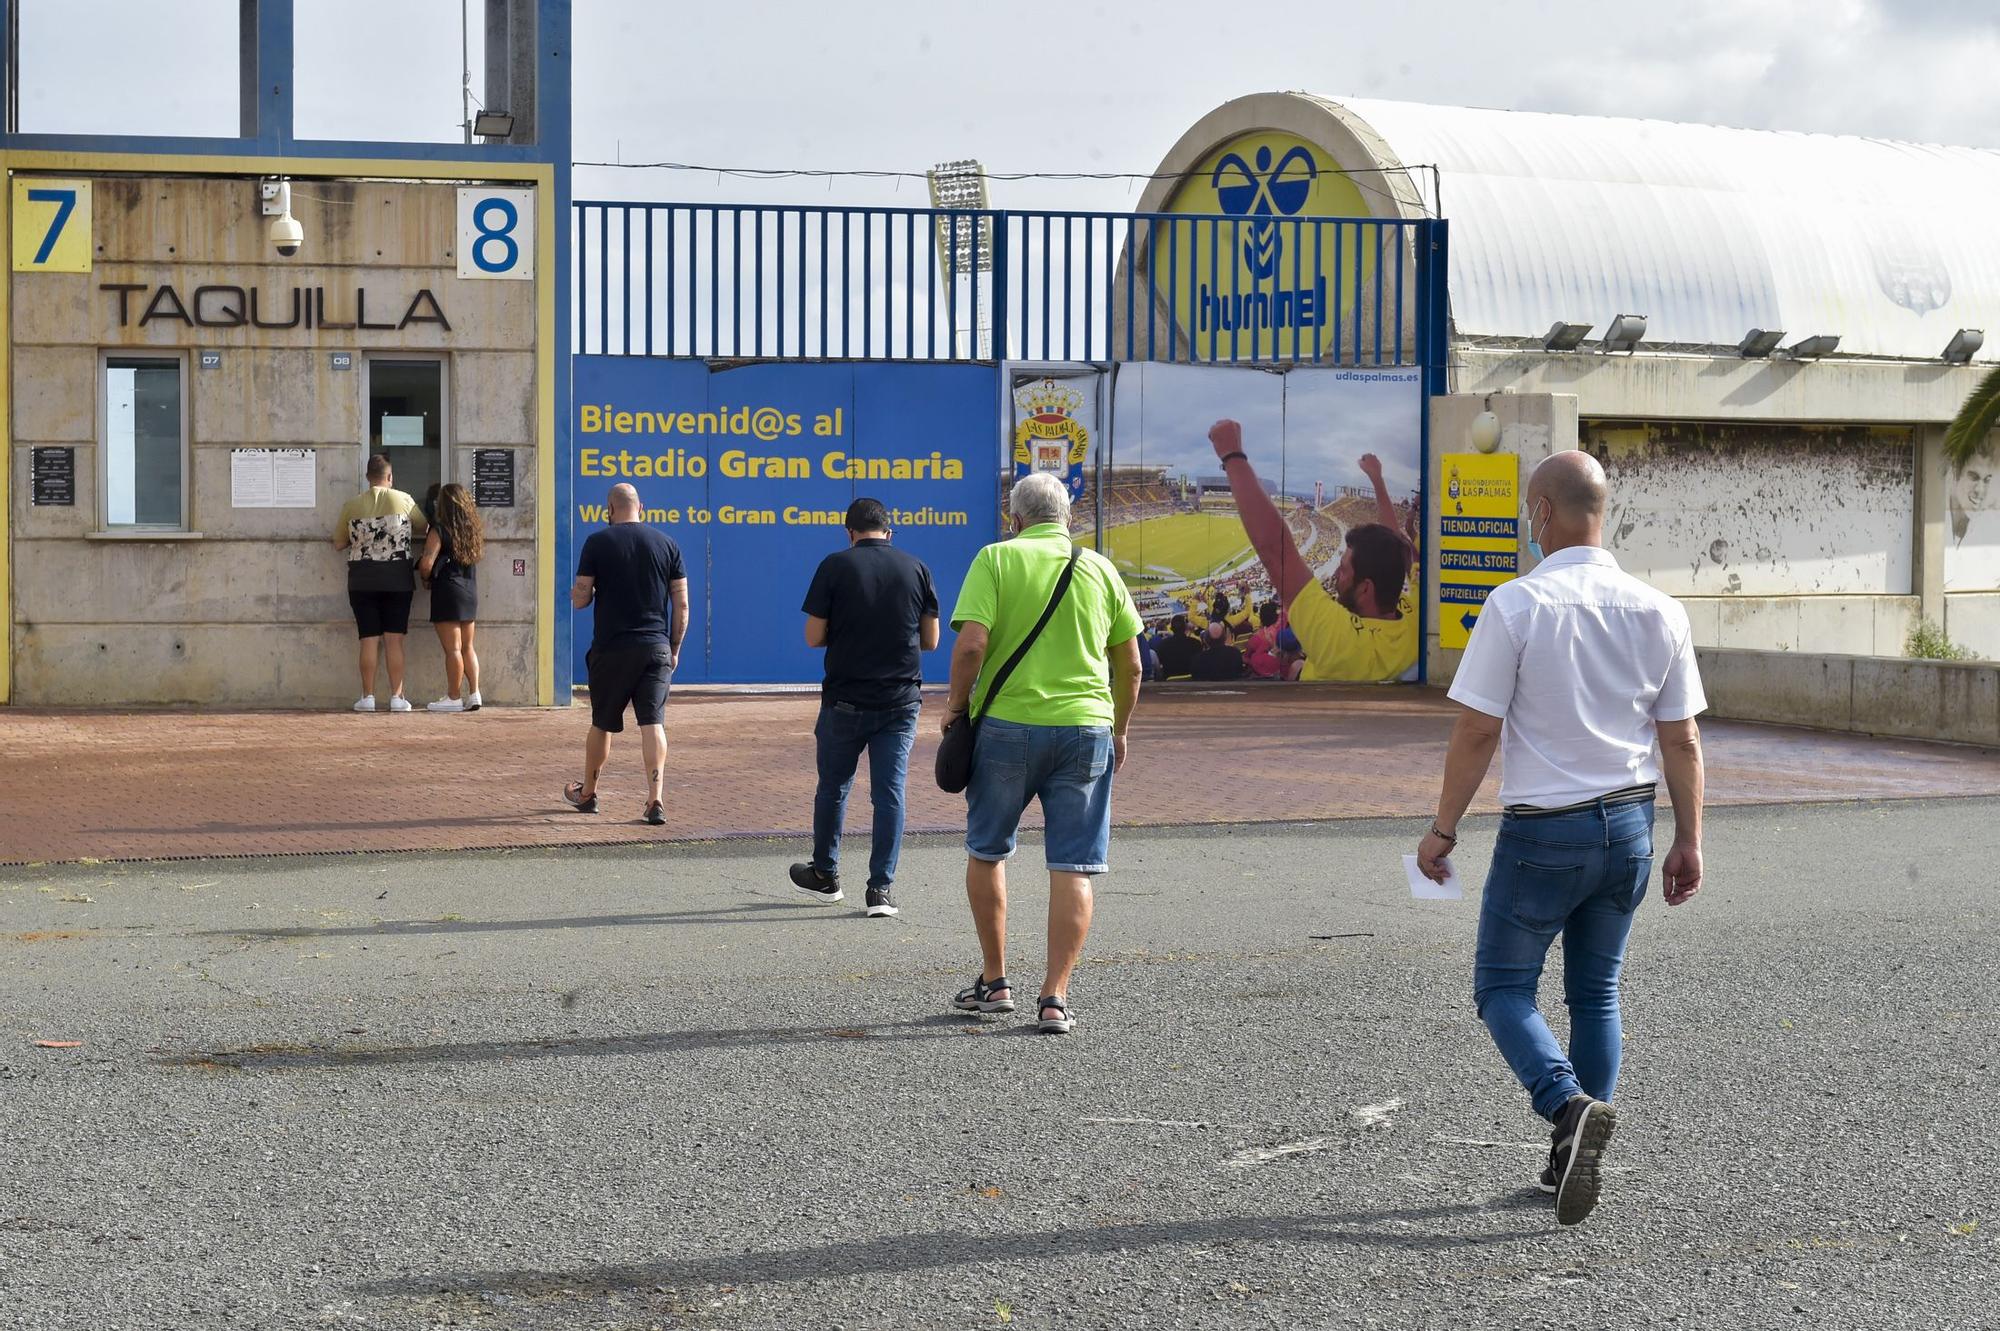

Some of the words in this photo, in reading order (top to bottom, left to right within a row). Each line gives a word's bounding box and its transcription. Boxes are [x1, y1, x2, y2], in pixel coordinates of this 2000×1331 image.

[28, 189, 76, 264] 7
[471, 198, 519, 273] 8
[100, 284, 451, 331] TAQUILLA
[1200, 275, 1326, 332] hummel
[202, 356, 219, 364] 07
[1335, 371, 1419, 384] udlaspalmas.es
[580, 404, 801, 441] Bienvenid@s
[813, 407, 842, 436] al
[580, 448, 708, 478] Estadio
[719, 450, 811, 479] Gran
[821, 451, 963, 480] Canaria
[687, 506, 712, 524] to
[718, 505, 777, 525] Gran
[1442, 520, 1476, 533] TIENDA
[1478, 521, 1516, 534] OFICIAL
[1441, 553, 1483, 567] OFFICIAL
[1484, 555, 1516, 569] STORE
[1440, 587, 1488, 600] OFFIZIELLER
